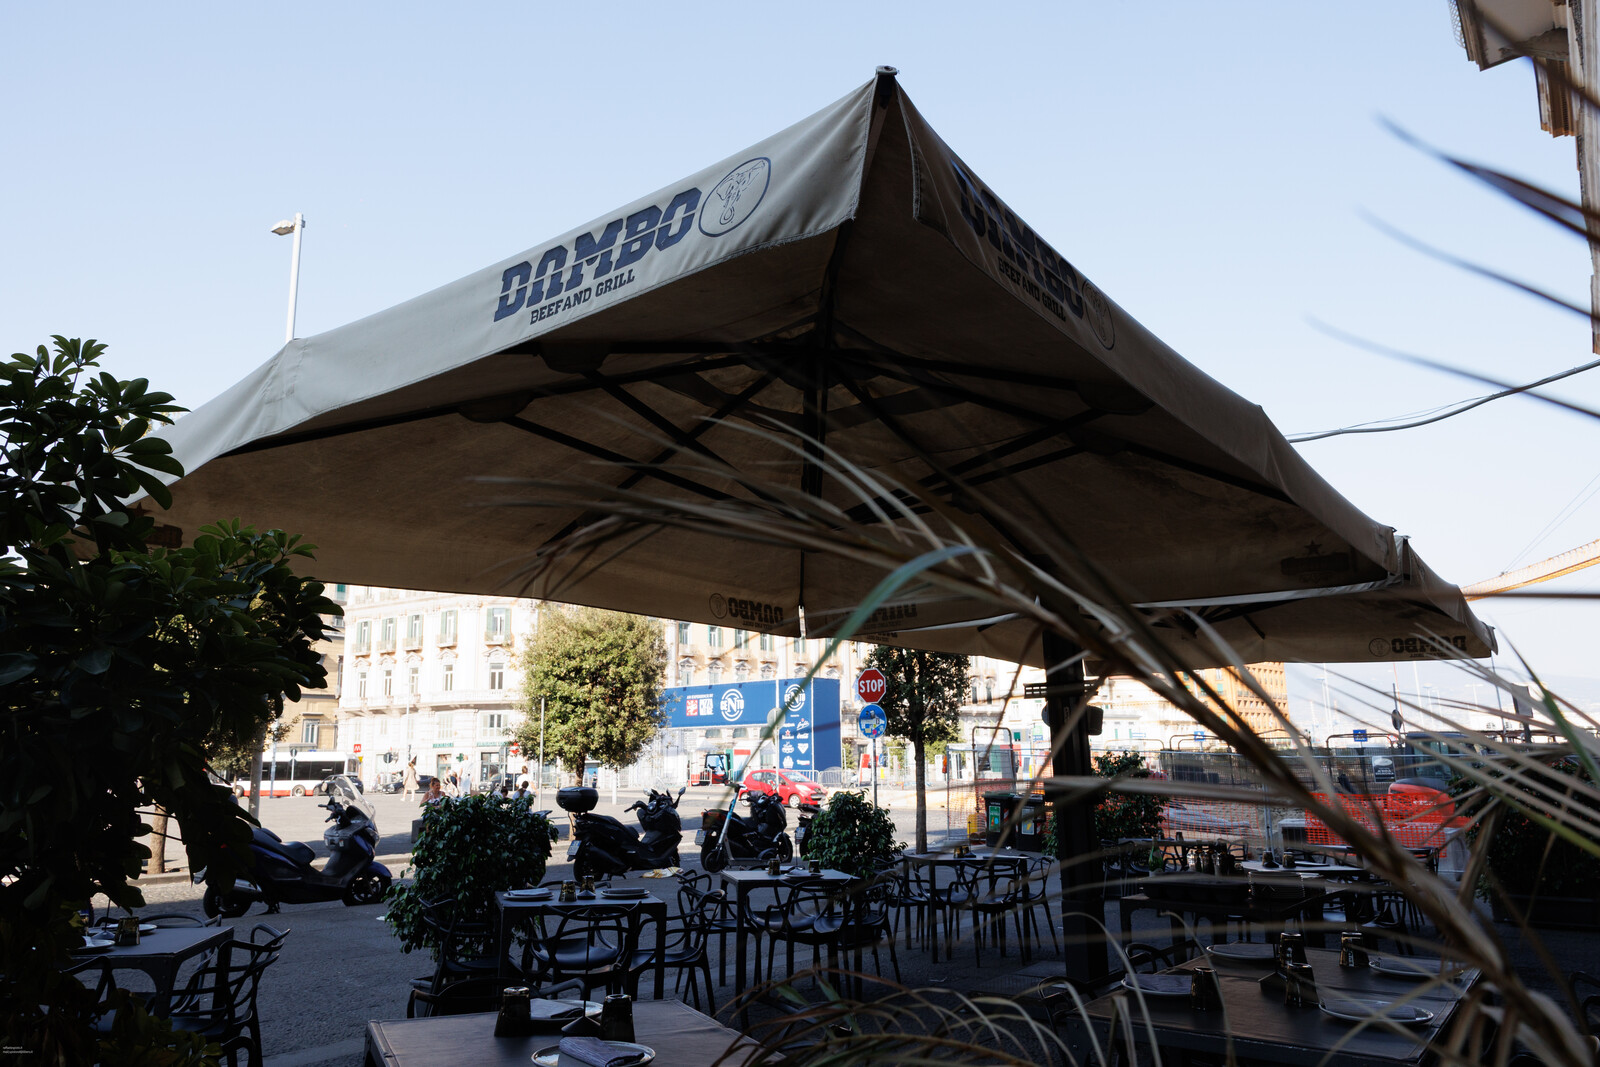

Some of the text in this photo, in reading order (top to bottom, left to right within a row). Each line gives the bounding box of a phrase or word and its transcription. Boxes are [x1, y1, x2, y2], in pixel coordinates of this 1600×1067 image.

[530, 269, 635, 325] BEEF AND GRILL
[1022, 274, 1040, 302] AND
[1042, 291, 1066, 322] GRILL
[859, 679, 884, 693] STOP
[720, 697, 744, 712] CENTO
